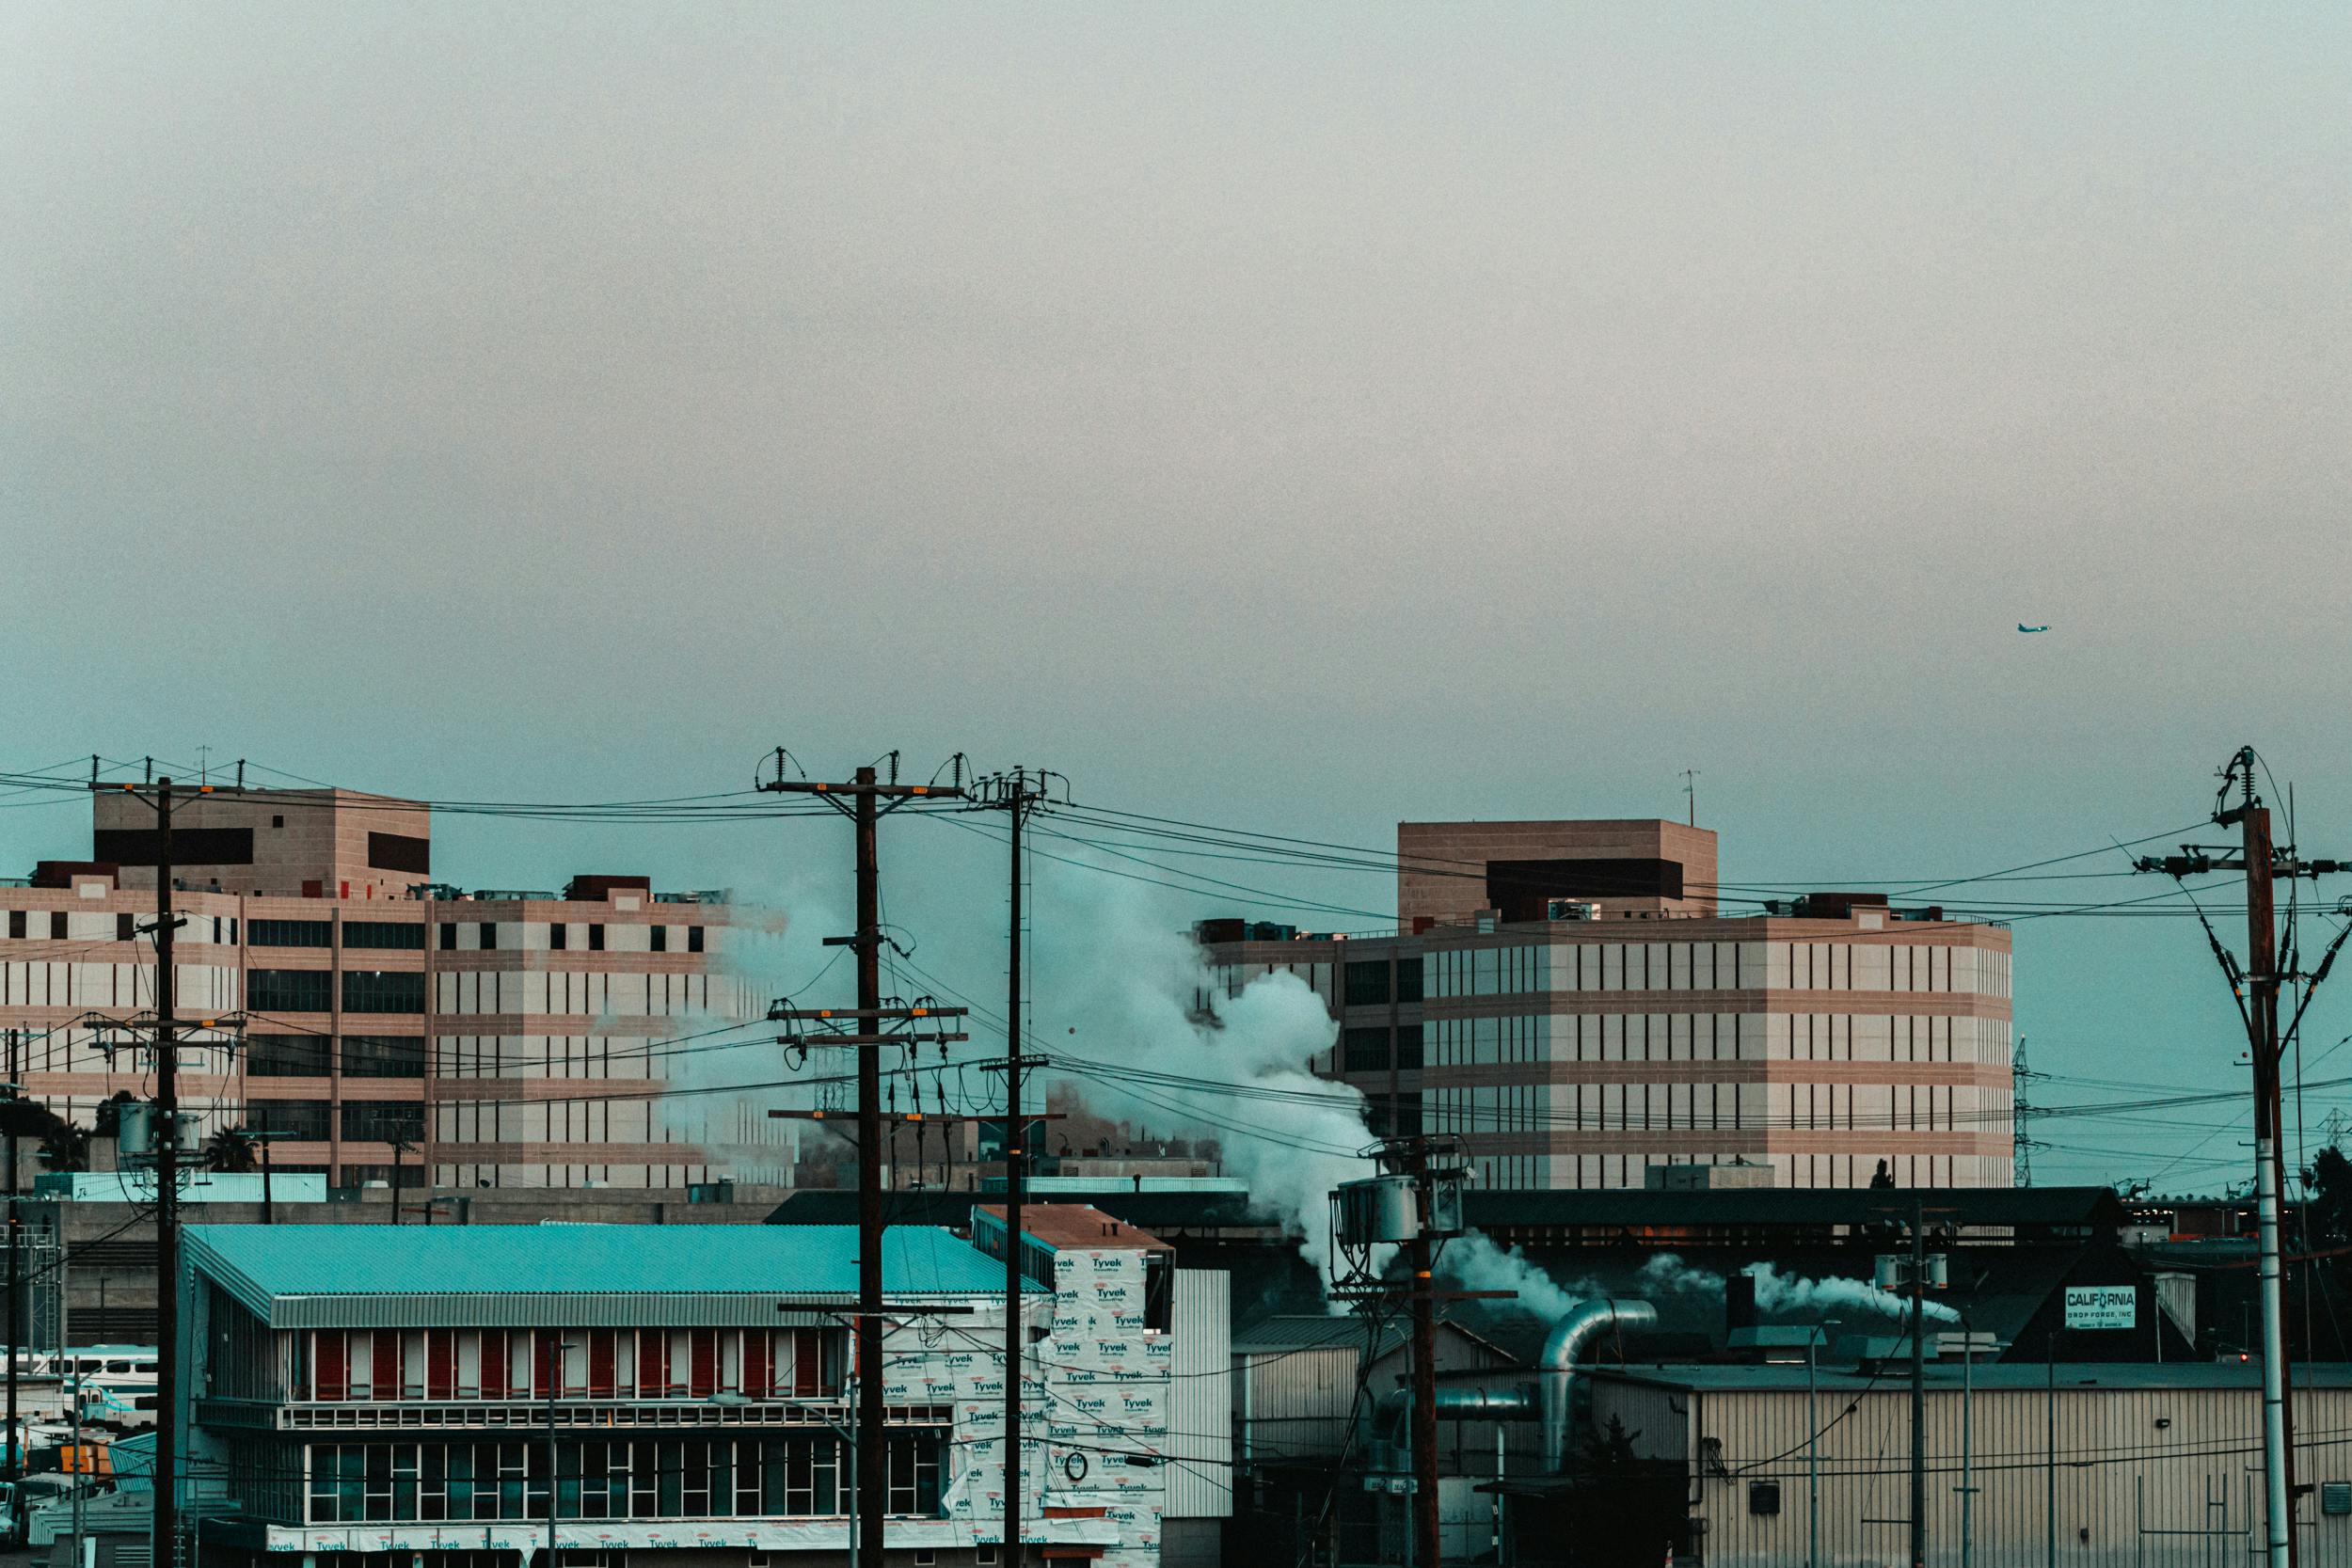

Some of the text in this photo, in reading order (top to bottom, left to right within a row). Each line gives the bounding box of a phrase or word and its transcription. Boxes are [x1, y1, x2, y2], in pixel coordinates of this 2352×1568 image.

[1092, 1258, 1122, 1268] Tyvek
[1056, 1290, 1079, 1301] yvek
[1097, 1288, 1126, 1299] Tyvek
[2067, 1293, 2134, 1307] CALIFORNIA
[1114, 1315, 1144, 1327] Tyvek
[1056, 1341, 1080, 1354] yvek
[1099, 1342, 1127, 1354] Tyvek
[946, 1354, 973, 1364] yvek
[1067, 1371, 1096, 1383] Tyvek
[882, 1384, 907, 1396] yvek
[926, 1383, 956, 1394] Tyvek
[974, 1381, 1003, 1392] Tyvek
[1076, 1399, 1105, 1410] Tyvek
[1123, 1398, 1152, 1409] Tyvek
[969, 1412, 998, 1422] Tyvek
[316, 1541, 346, 1550] Tyvek
[556, 1540, 580, 1549] yvek
[600, 1540, 628, 1549] Tyvek
[649, 1539, 678, 1548] Tyvek
